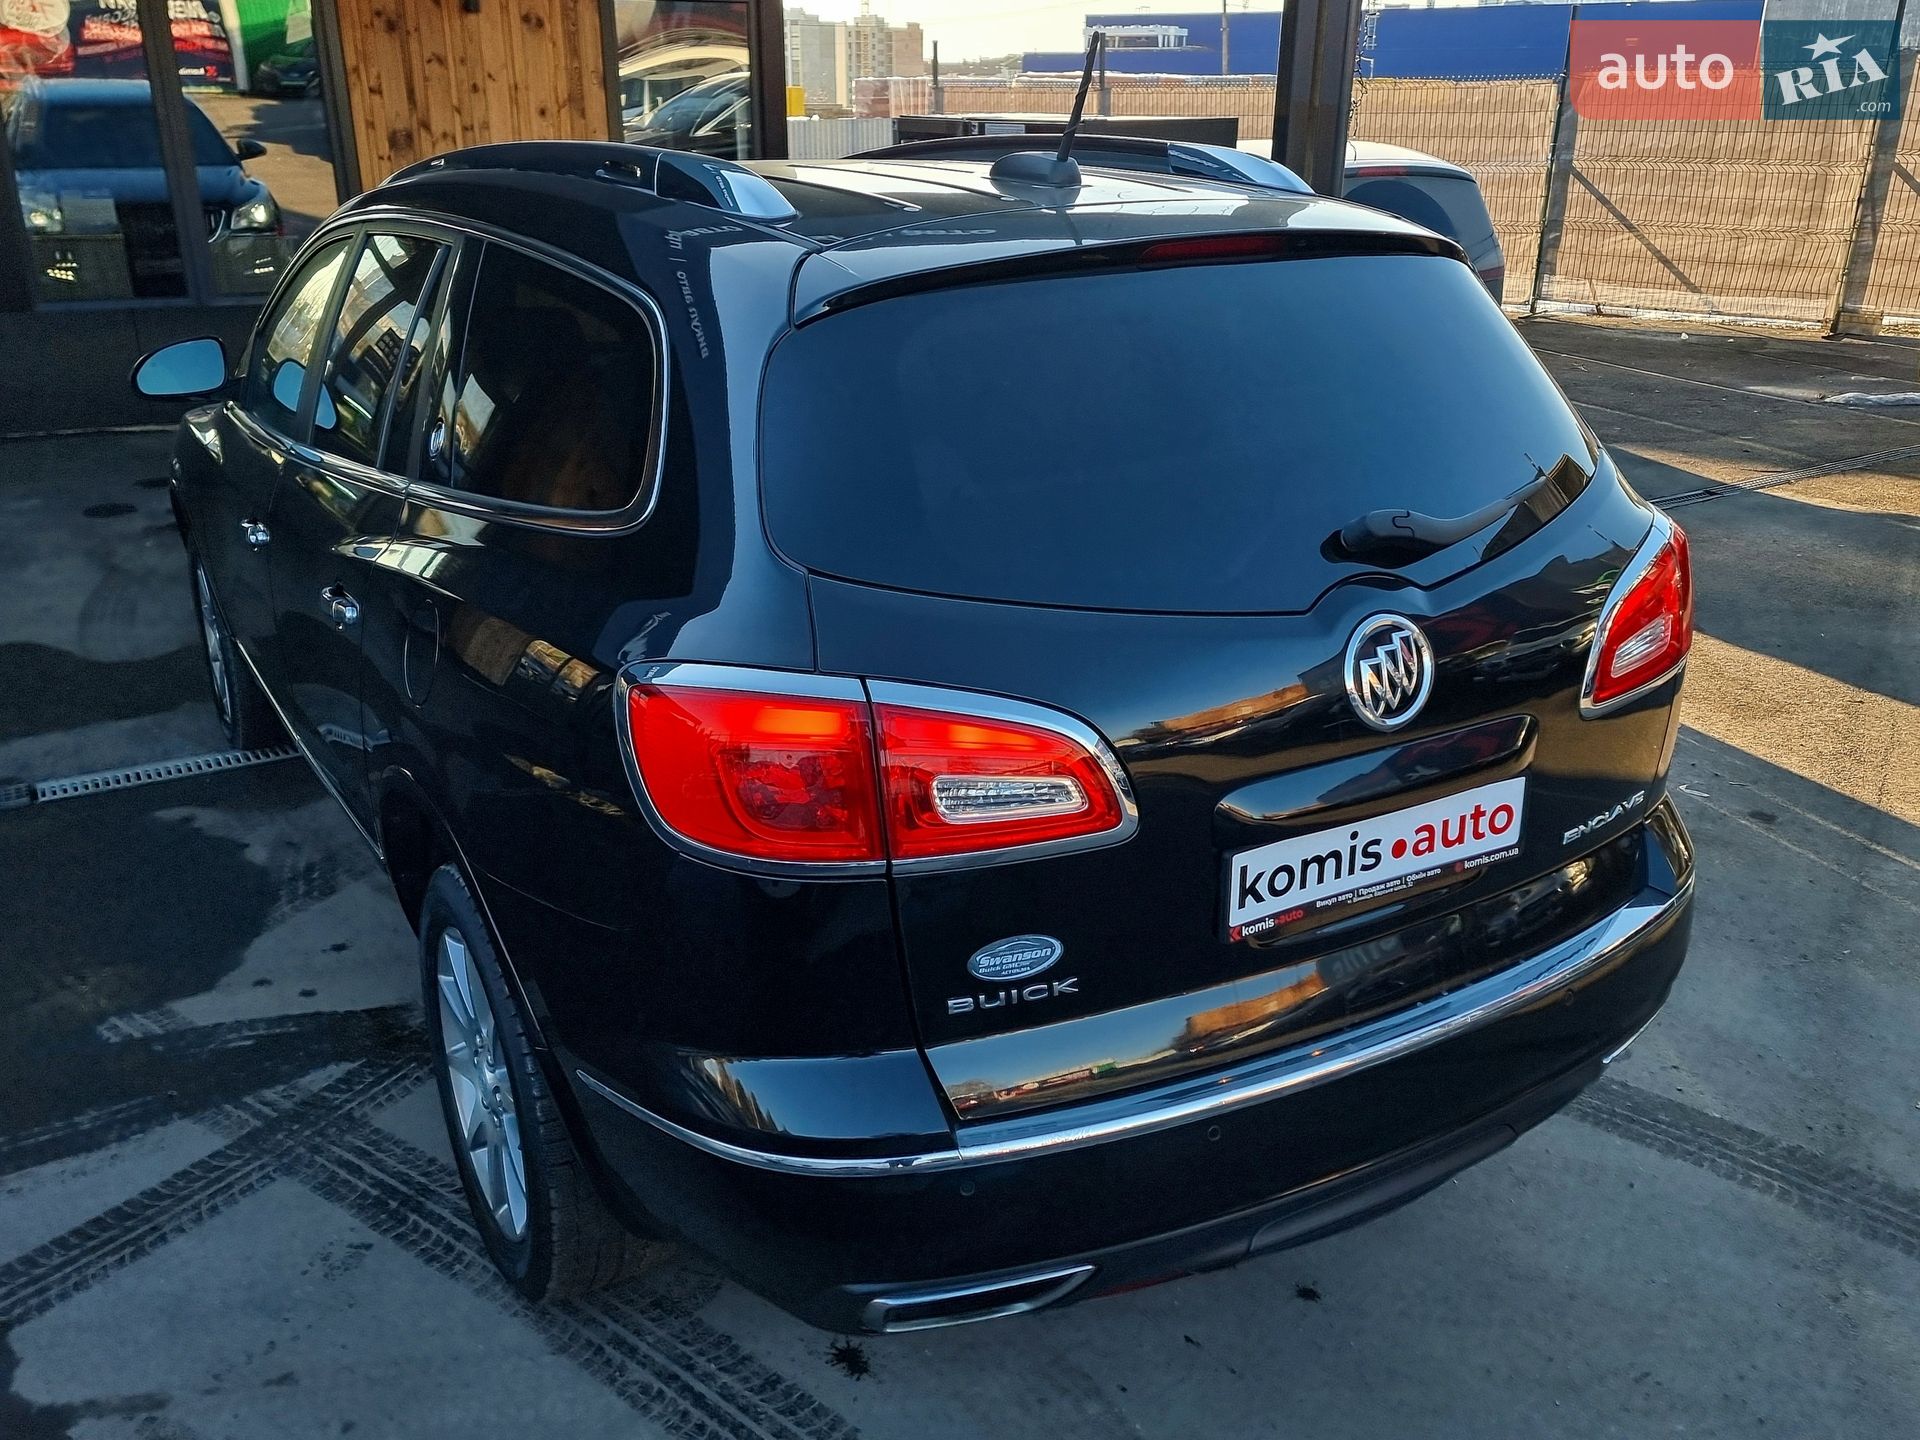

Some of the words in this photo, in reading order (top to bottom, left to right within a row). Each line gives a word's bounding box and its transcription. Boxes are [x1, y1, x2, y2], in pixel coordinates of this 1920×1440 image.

[1562, 790, 1645, 845] ENCLAVE
[1238, 830, 1383, 910] komis
[1464, 847, 1519, 869] komis.com.ua
[1242, 917, 1275, 937] komis
[979, 947, 1052, 968] Swanson
[947, 977, 1079, 1015] BUICK
